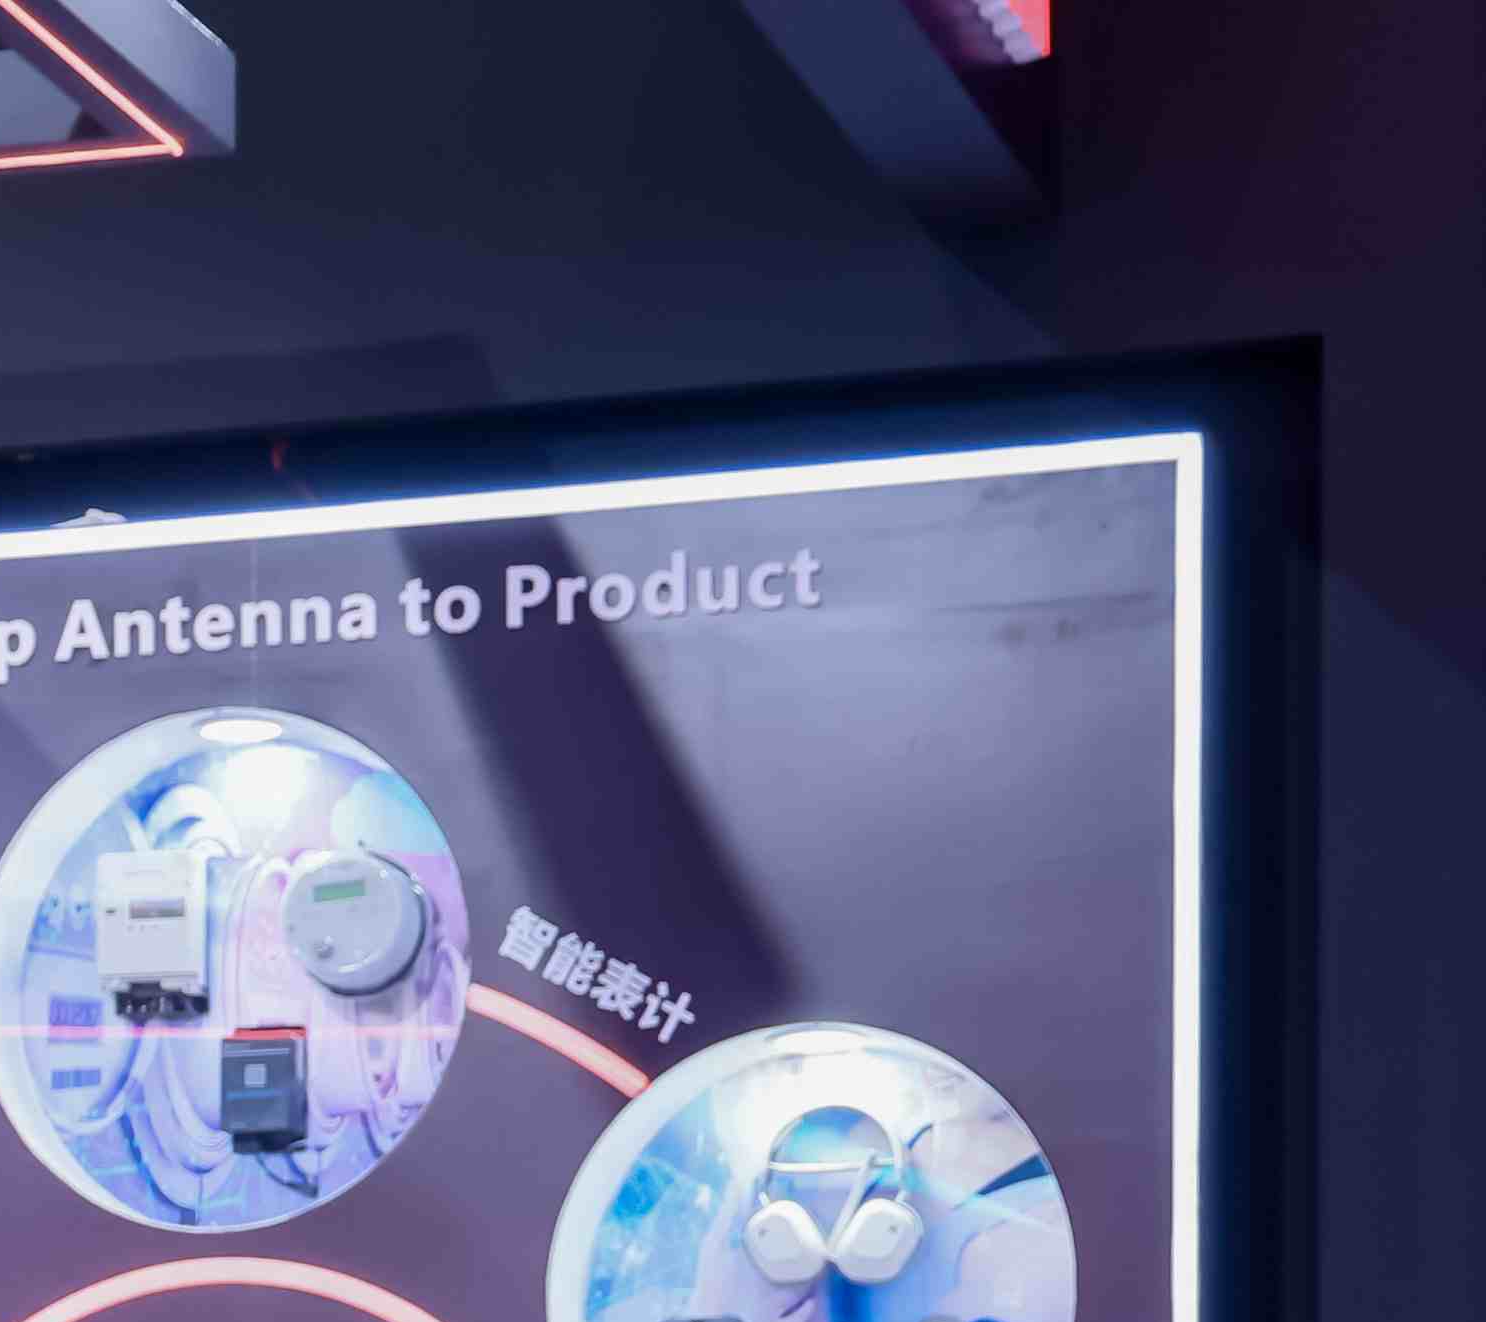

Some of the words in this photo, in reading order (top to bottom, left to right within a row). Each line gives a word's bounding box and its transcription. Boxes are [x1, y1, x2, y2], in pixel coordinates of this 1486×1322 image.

[53, 592, 377, 664] Antenna
[400, 577, 482, 638] to
[504, 547, 822, 630] Product
[498, 904, 696, 1043] 智能表计
